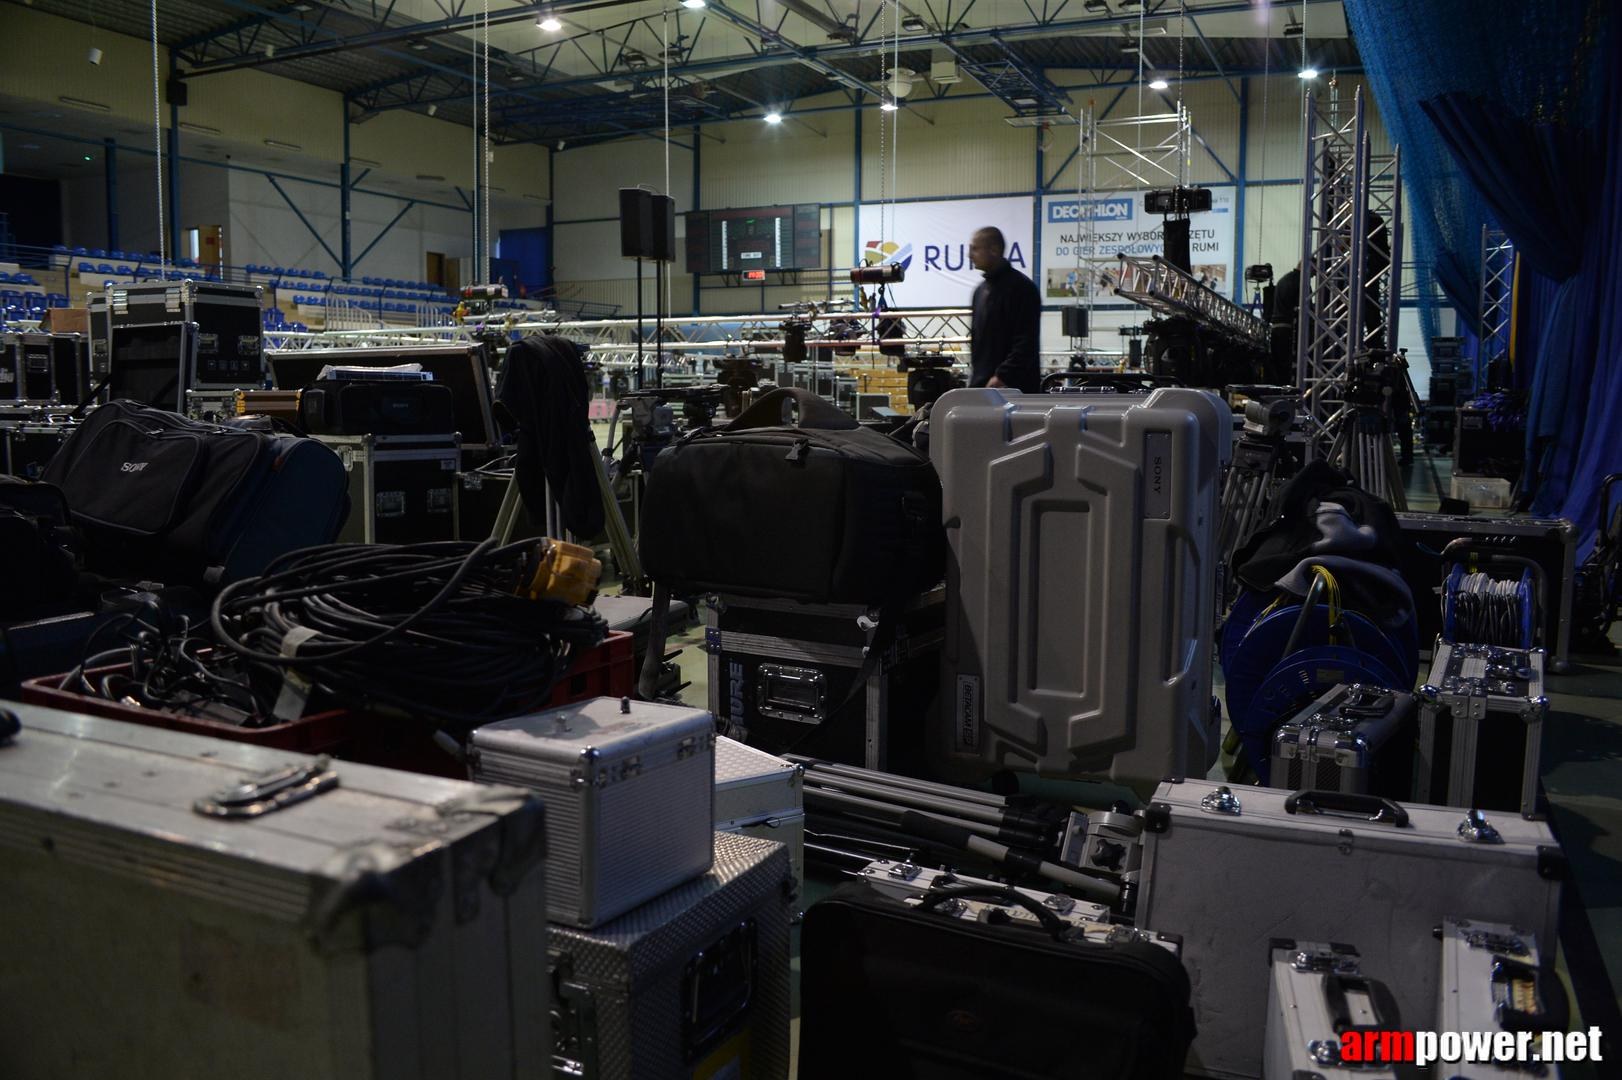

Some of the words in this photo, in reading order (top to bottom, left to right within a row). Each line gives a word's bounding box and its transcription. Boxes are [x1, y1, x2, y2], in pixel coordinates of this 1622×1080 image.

[1056, 246, 1069, 256] DO
[1193, 242, 1219, 252] RUMI
[1153, 456, 1162, 494] SONY
